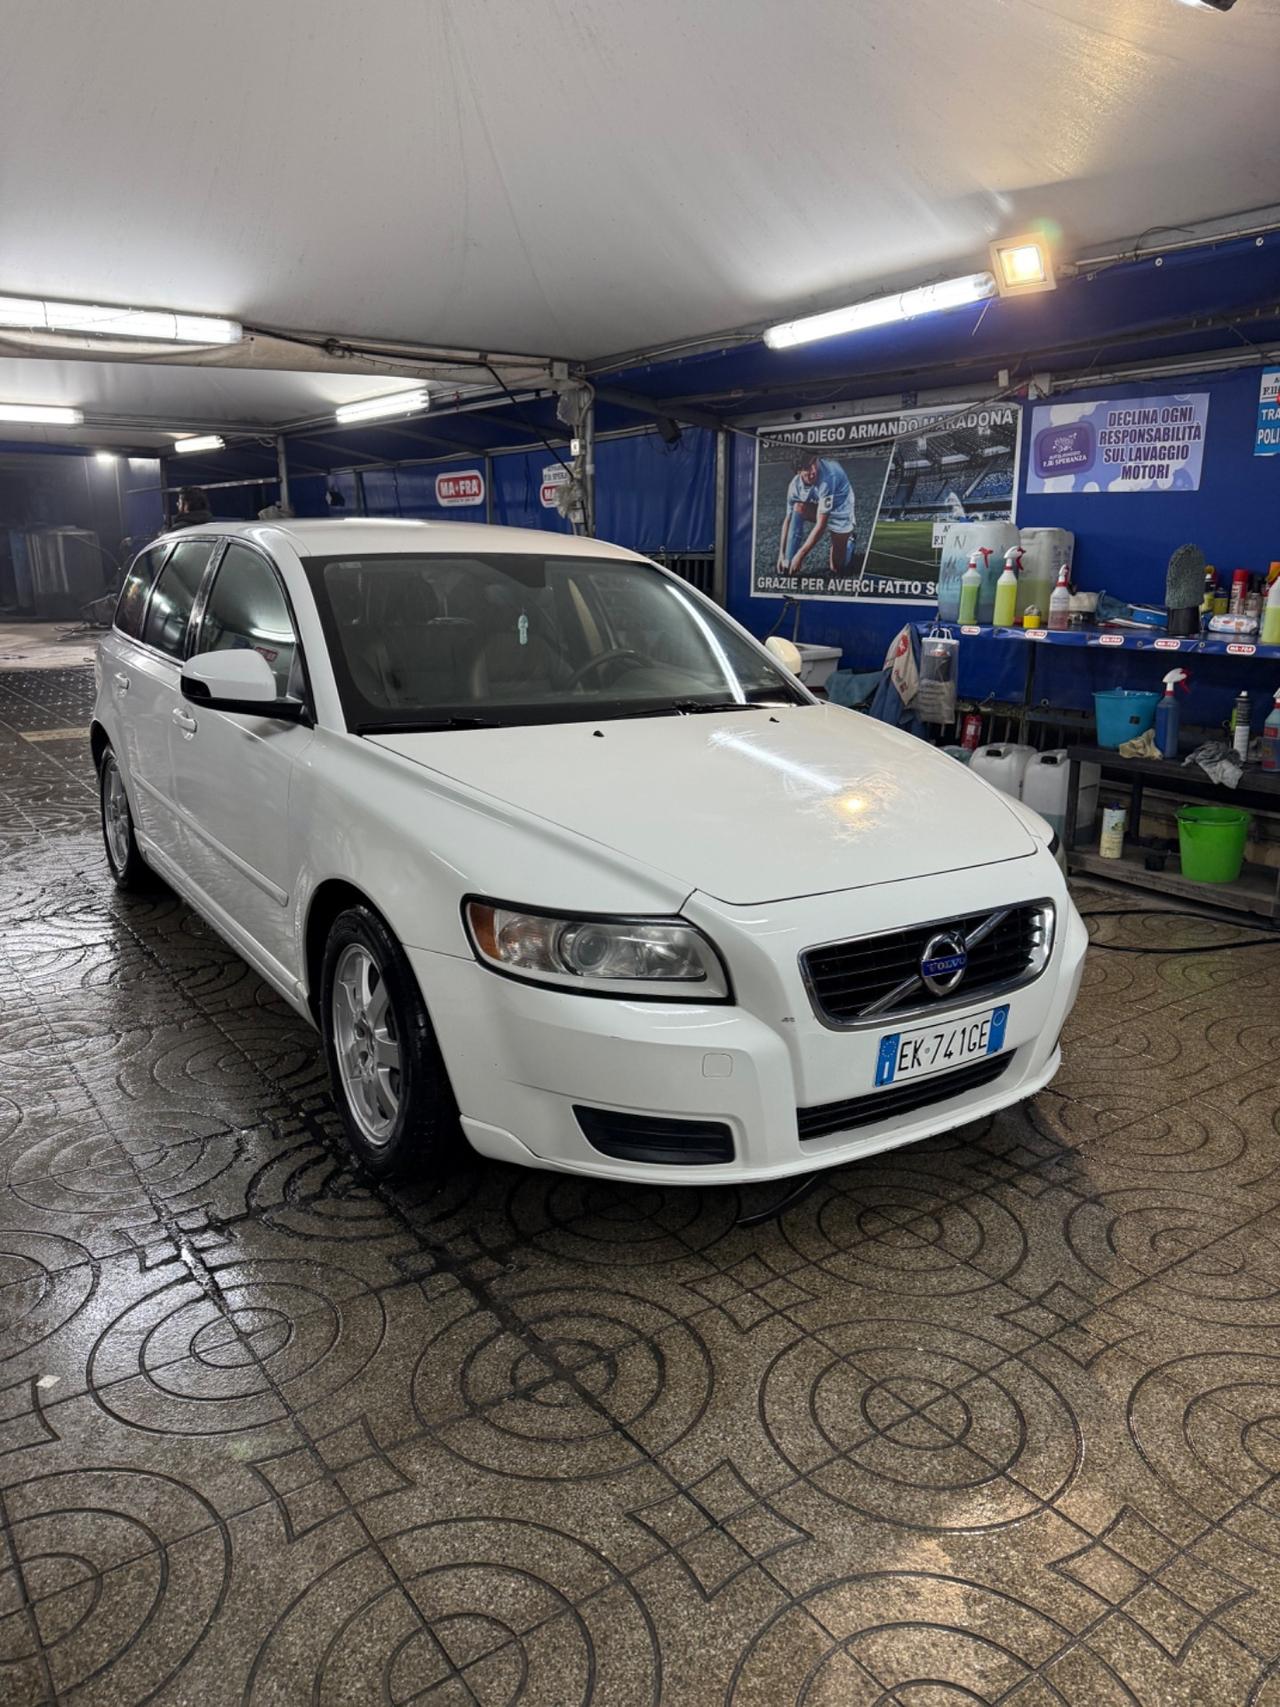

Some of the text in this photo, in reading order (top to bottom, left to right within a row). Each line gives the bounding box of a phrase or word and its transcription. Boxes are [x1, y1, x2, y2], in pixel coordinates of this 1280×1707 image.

[1108, 406, 1194, 427] DECLINA OGNI
[762, 408, 1013, 450] STADIO DIEGO ARMANDO MARADONA
[1099, 422, 1202, 446] RESPONSABILITÀ
[1104, 444, 1190, 463] SUL LAVAGGIO
[1121, 463, 1171, 481] MOTORI
[757, 577, 798, 590] GRAZIE
[801, 578, 824, 591] PER
[827, 579, 874, 593] AVERCI
[878, 580, 921, 595] FATTO
[927, 958, 966, 974] VOLVO
[898, 1037, 925, 1072] EK
